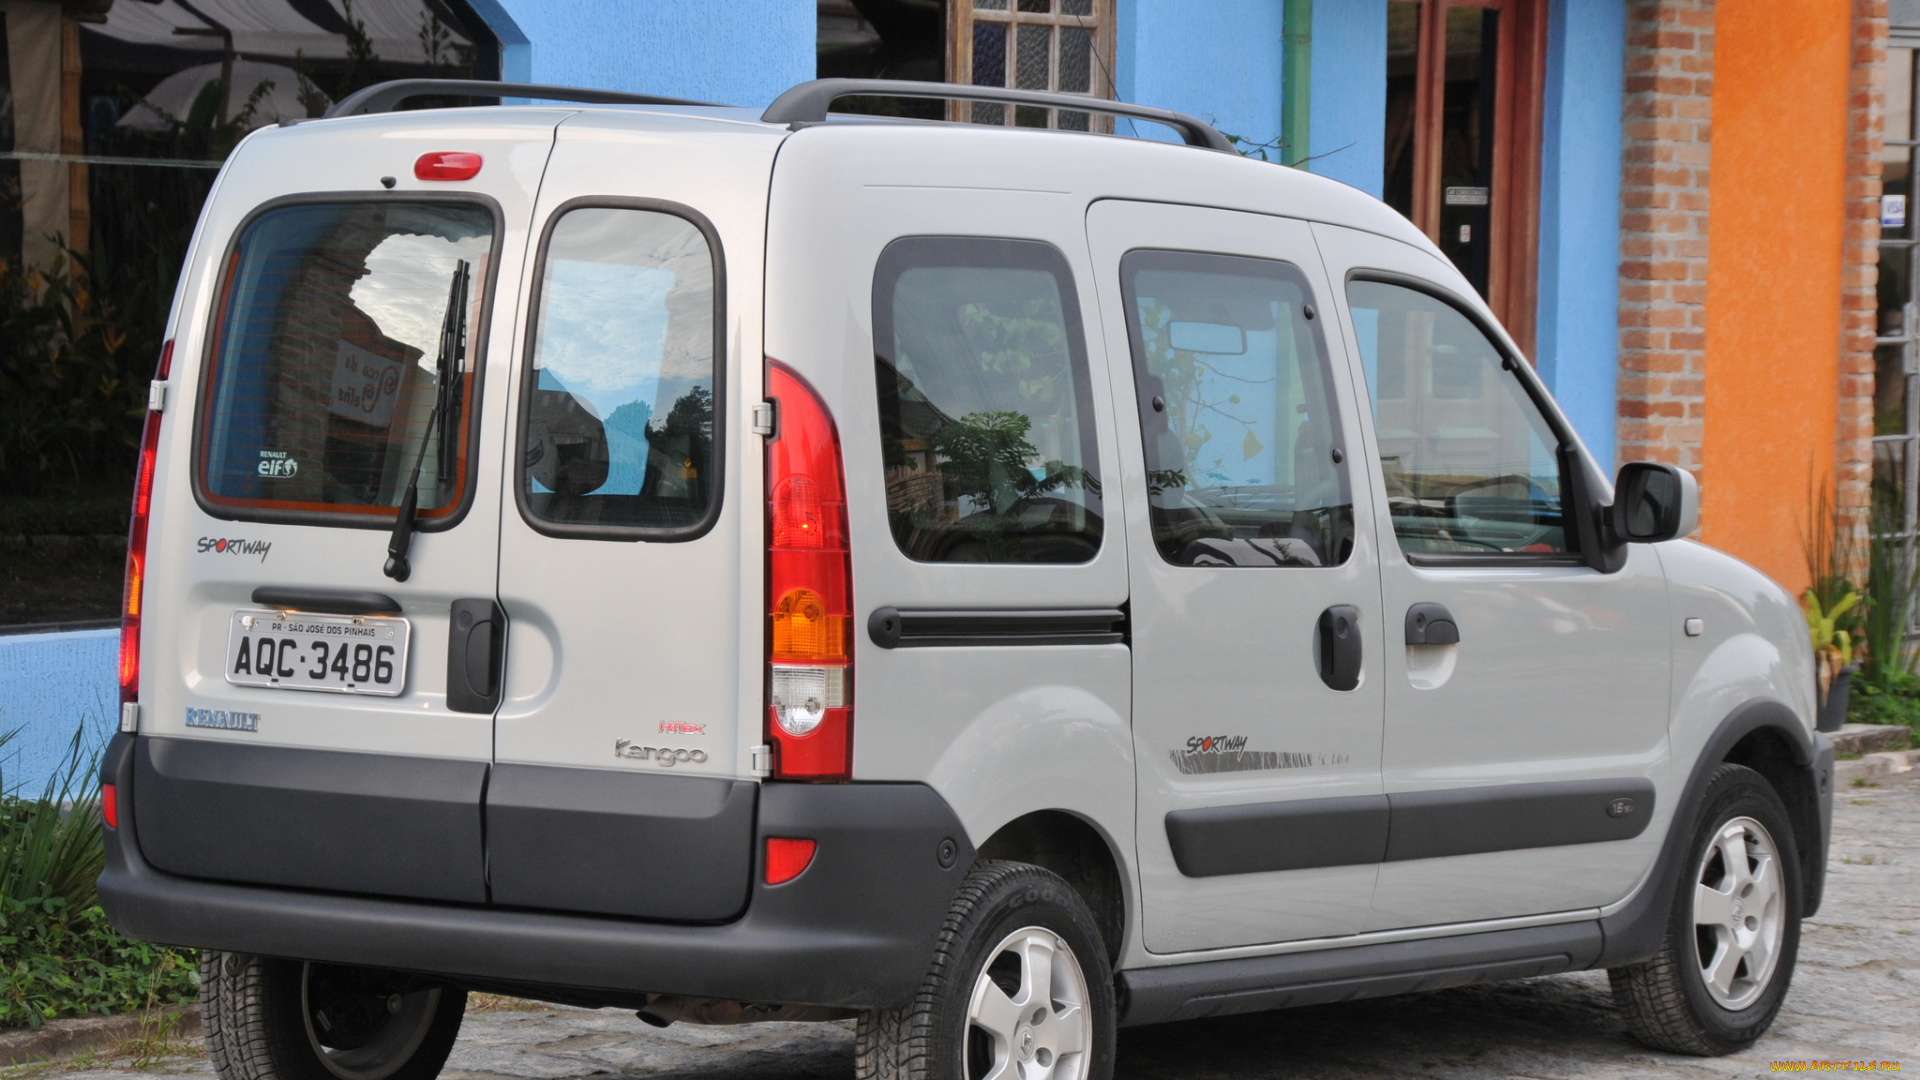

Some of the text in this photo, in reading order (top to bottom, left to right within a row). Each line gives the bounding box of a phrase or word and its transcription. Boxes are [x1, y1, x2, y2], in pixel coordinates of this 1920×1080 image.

[258, 460, 283, 475] elf
[197, 536, 272, 563] SPORTWAY
[271, 622, 282, 631] PR
[288, 623, 303, 633] SÃO
[306, 624, 324, 634] JOSÉ
[326, 626, 342, 635] DOS
[344, 627, 376, 637] PINHAIS
[185, 707, 261, 732] RENAULT
[615, 737, 707, 767] Kangoo
[1187, 735, 1248, 761] SPORTWAY
